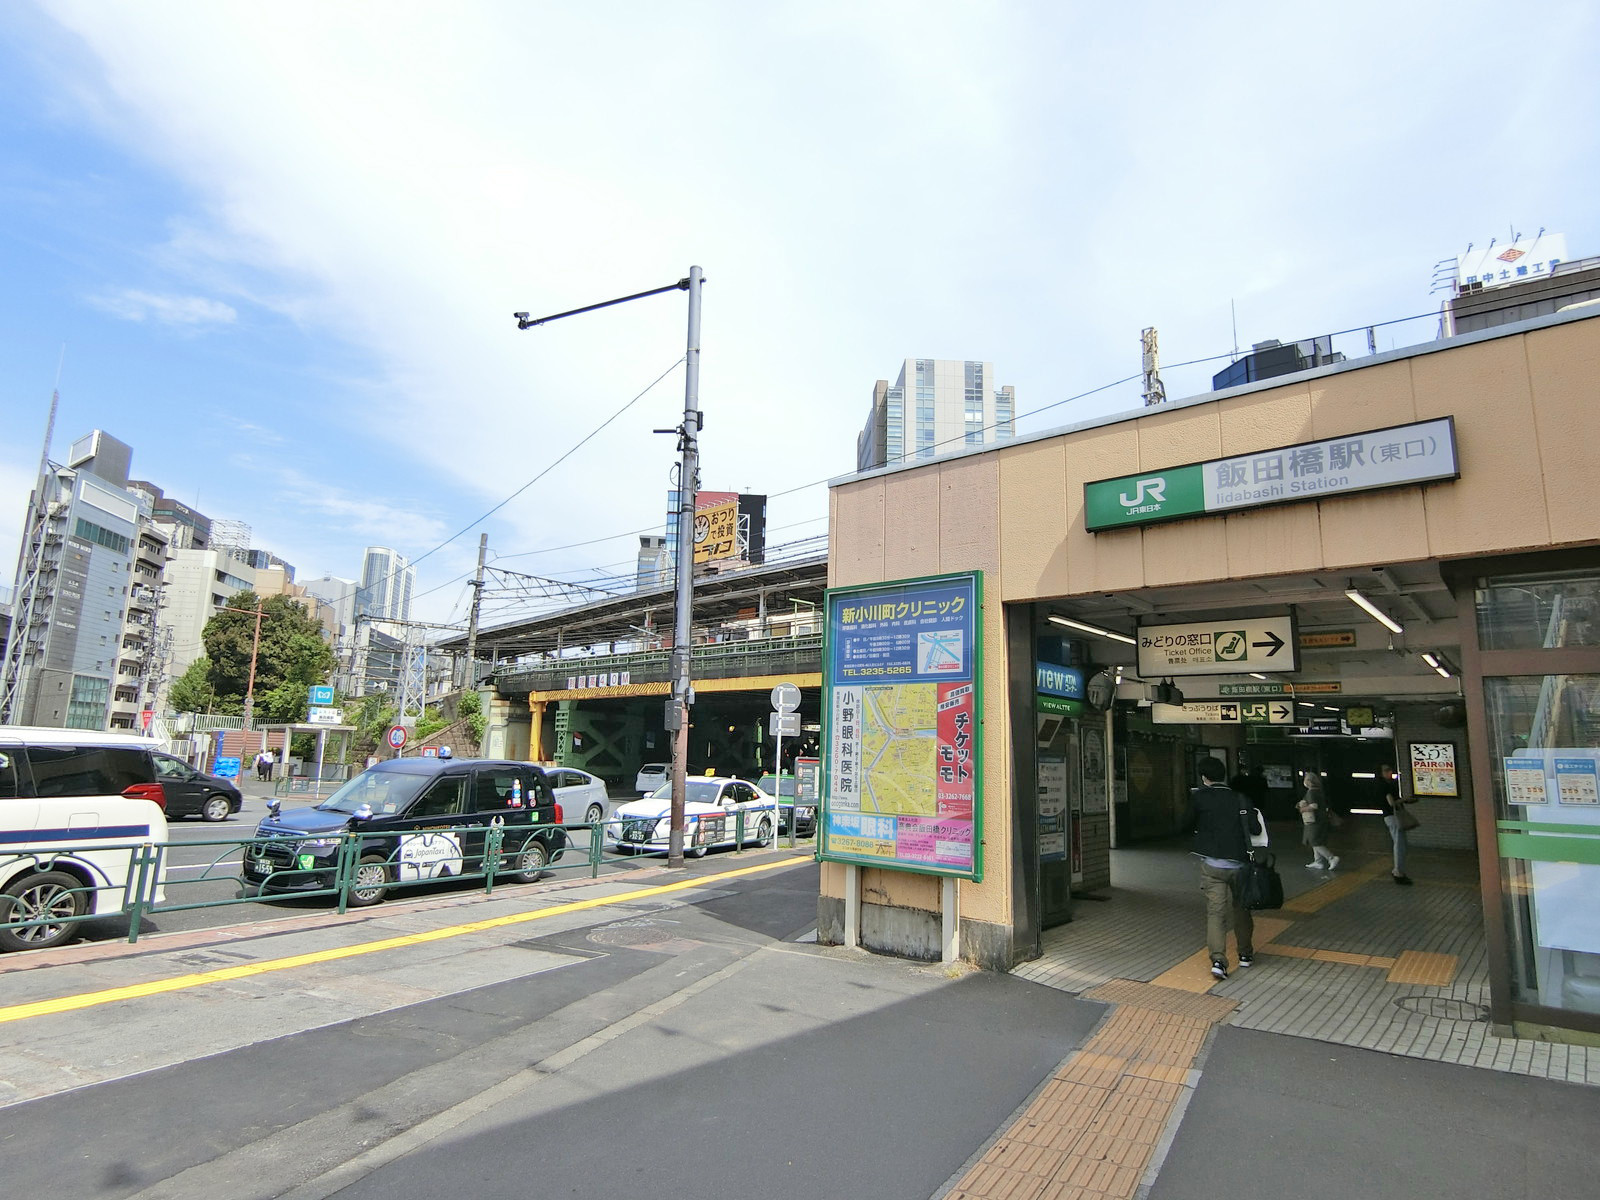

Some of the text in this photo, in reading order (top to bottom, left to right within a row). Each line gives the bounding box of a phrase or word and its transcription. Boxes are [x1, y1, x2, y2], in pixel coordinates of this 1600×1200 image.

[1119, 477, 1167, 507] JR
[1216, 475, 1349, 505] Iidabashi Station
[711, 508, 735, 526] おつり
[1126, 503, 1162, 516] JR東日本
[710, 523, 734, 540] で投資
[842, 596, 965, 624] 新小川町クリニック
[1141, 633, 1212, 648] みどりの窓口
[1189, 647, 1212, 656] Office
[1242, 704, 1266, 717] JR
[840, 690, 855, 793] 小野眼科医院
[955, 713, 970, 783] チケット
[940, 745, 954, 783] モモ
